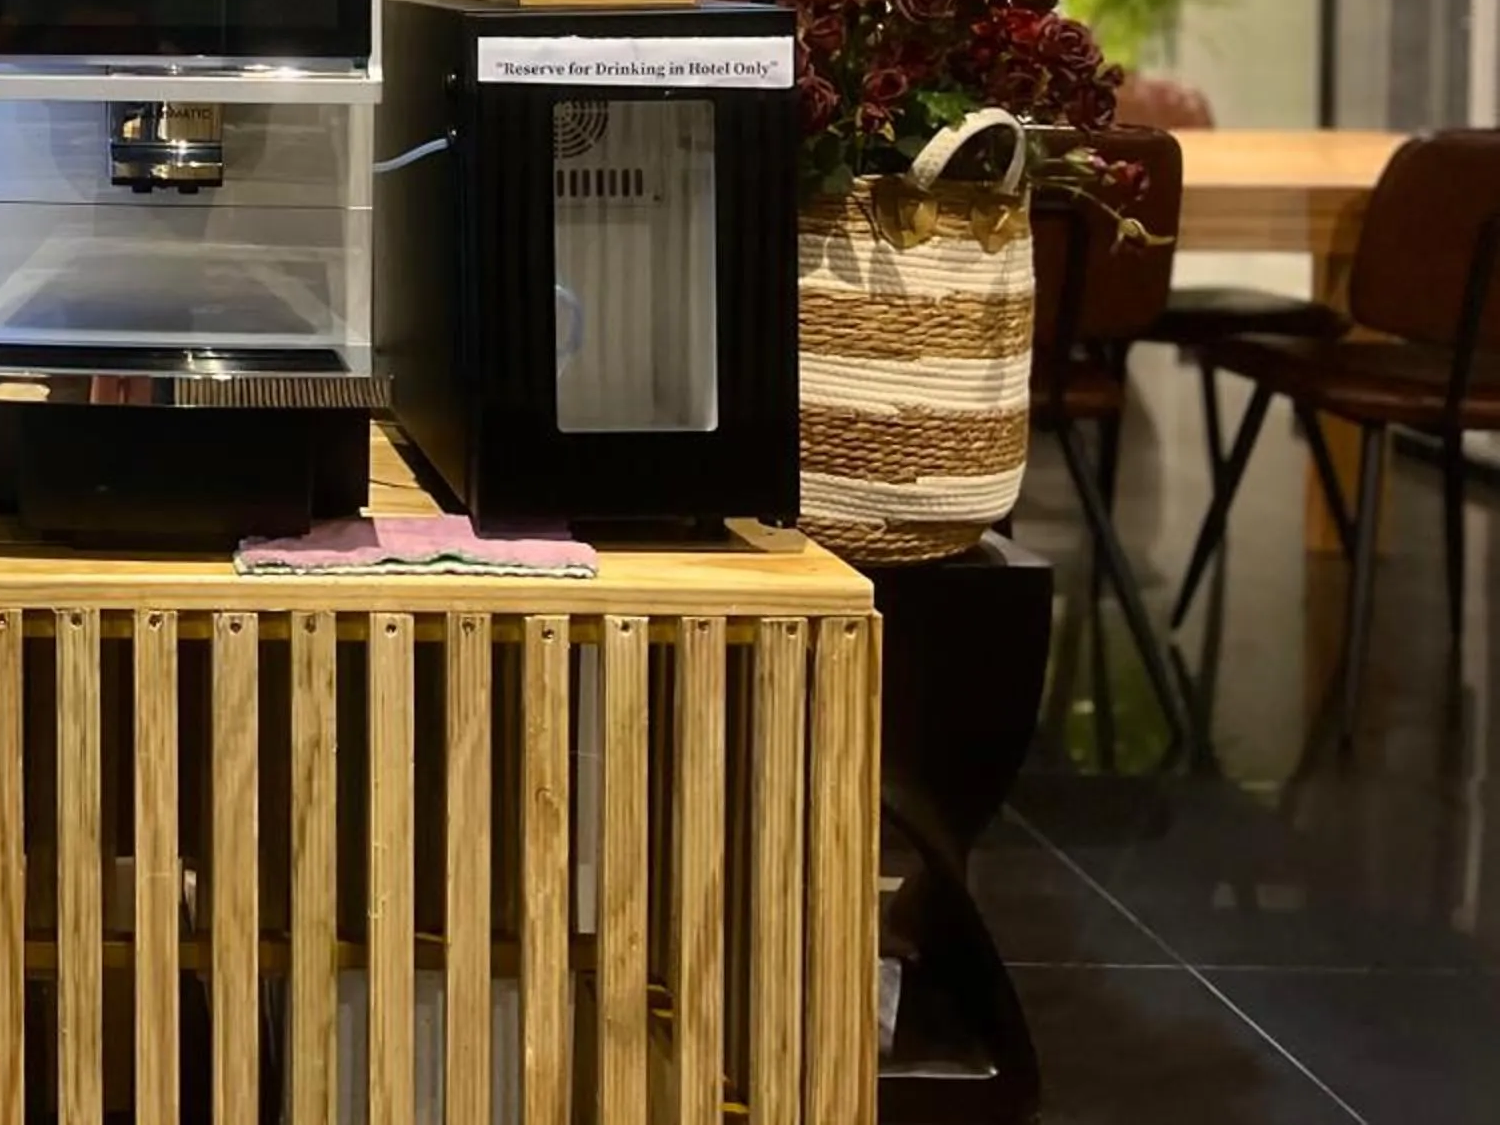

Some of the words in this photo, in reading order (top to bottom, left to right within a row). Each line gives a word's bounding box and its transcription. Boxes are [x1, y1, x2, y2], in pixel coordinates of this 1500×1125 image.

[569, 60, 592, 76] for
[595, 61, 666, 79] Drinking
[669, 61, 685, 76] in
[689, 61, 730, 76] Hotel
